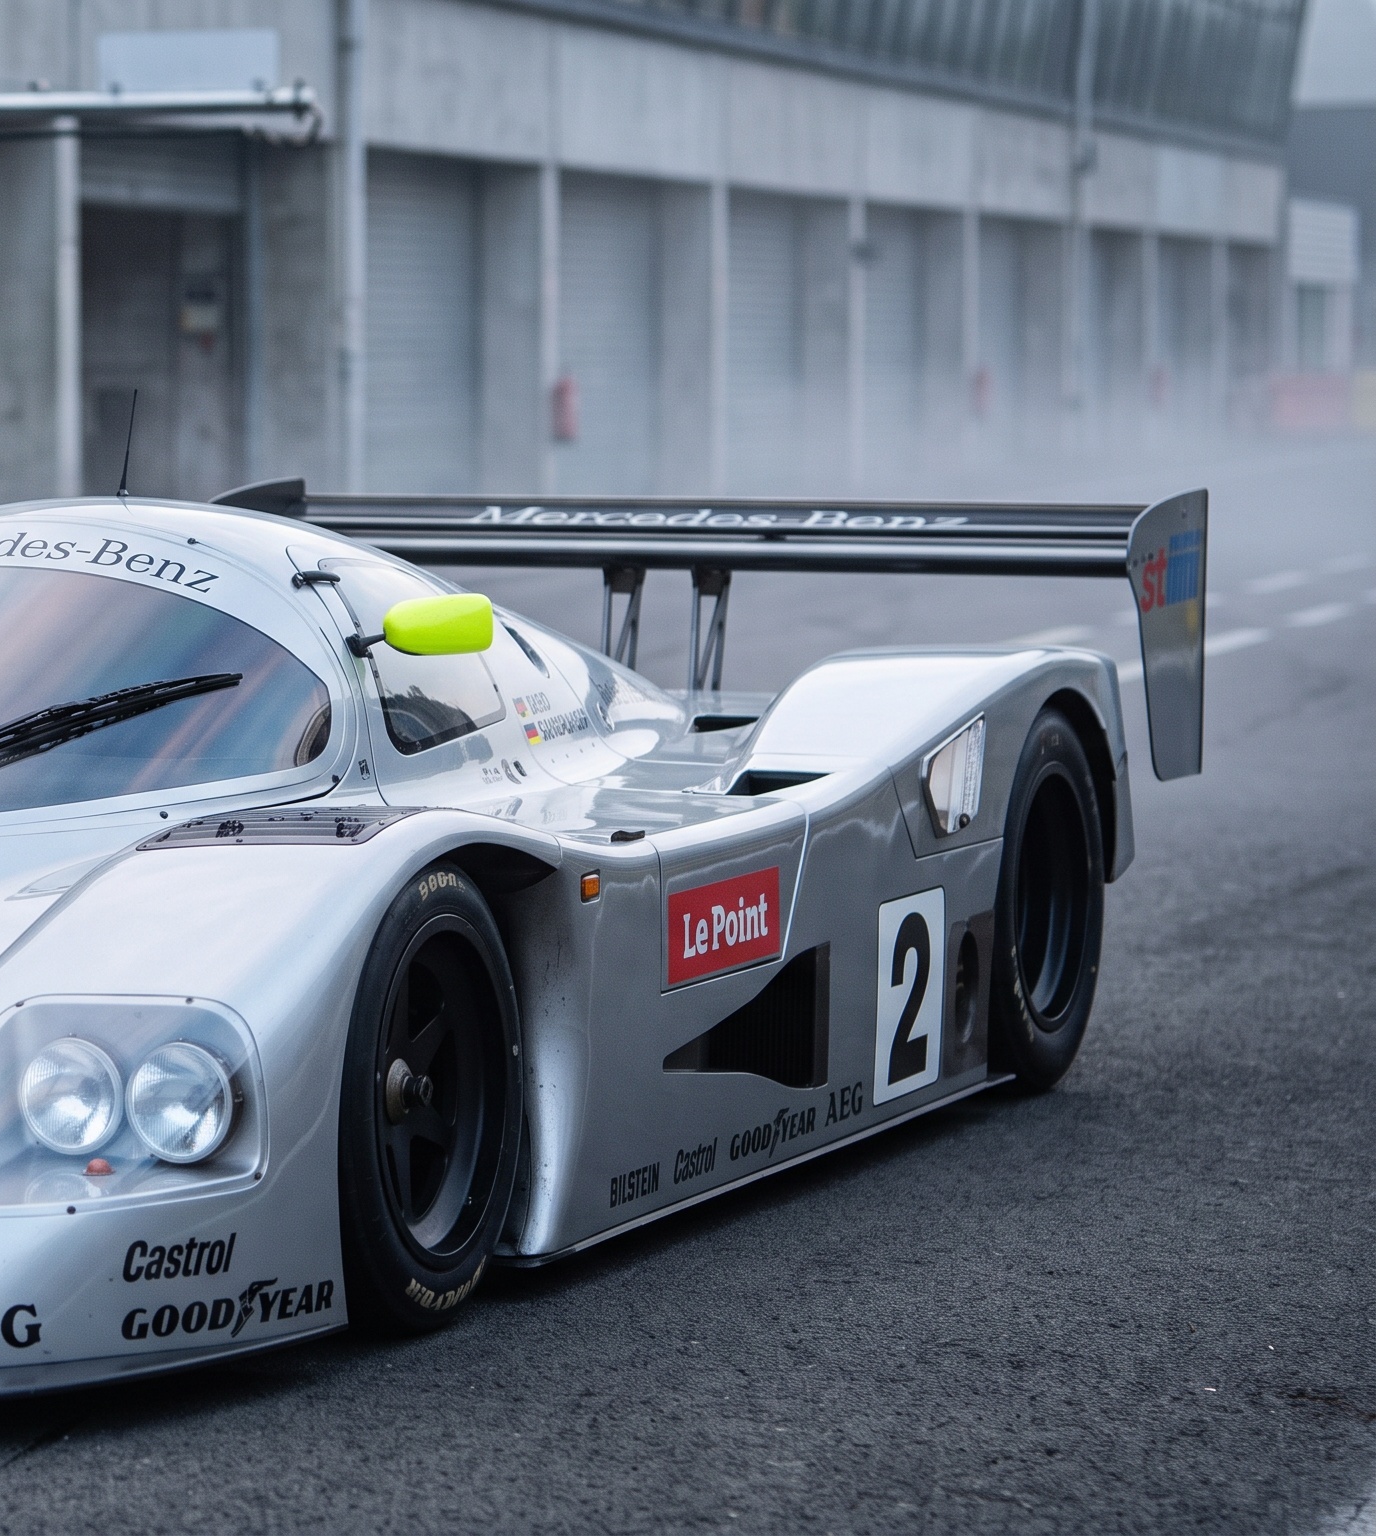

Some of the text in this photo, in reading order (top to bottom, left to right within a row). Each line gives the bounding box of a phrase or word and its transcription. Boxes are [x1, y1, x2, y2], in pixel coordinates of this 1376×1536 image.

[471, 505, 970, 528] Mercedes-Benz
[683, 893, 768, 960] Le Point
[887, 911, 931, 1087] 2
[609, 1082, 863, 1208] BILSTEIN Castrol GOODYEAR AEG
[123, 1233, 236, 1282] Castrol
[121, 1278, 334, 1340] GOODYEAR
